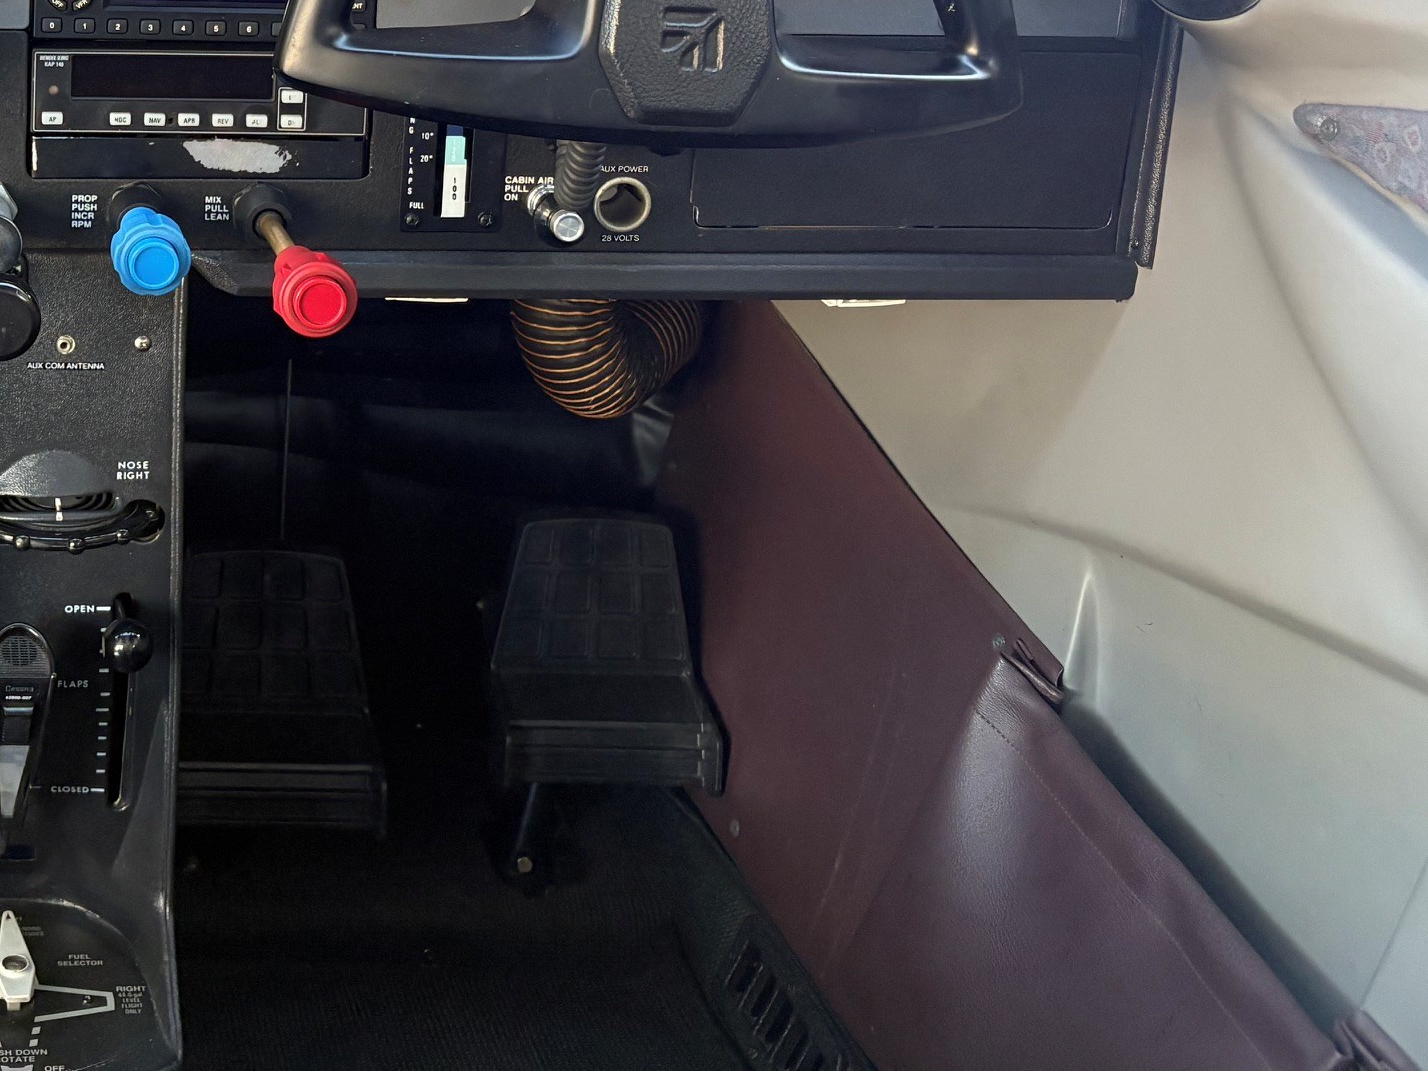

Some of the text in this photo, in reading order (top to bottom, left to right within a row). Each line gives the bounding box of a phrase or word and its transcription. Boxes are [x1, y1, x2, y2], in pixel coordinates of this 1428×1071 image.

[505, 176, 534, 184] CABIN
[72, 195, 98, 203] PROP
[205, 196, 222, 204] MIX
[72, 203, 98, 212] PUSH
[205, 205, 228, 213] PULL
[205, 213, 230, 221] LEAN
[601, 234, 639, 242] 28 VOLTS
[117, 461, 149, 470] NOSE
[116, 470, 150, 480] RIGHT
[65, 604, 95, 613] OPEN
[57, 959, 103, 967] SELECTOR
[15, 1048, 48, 1056] DOWN
